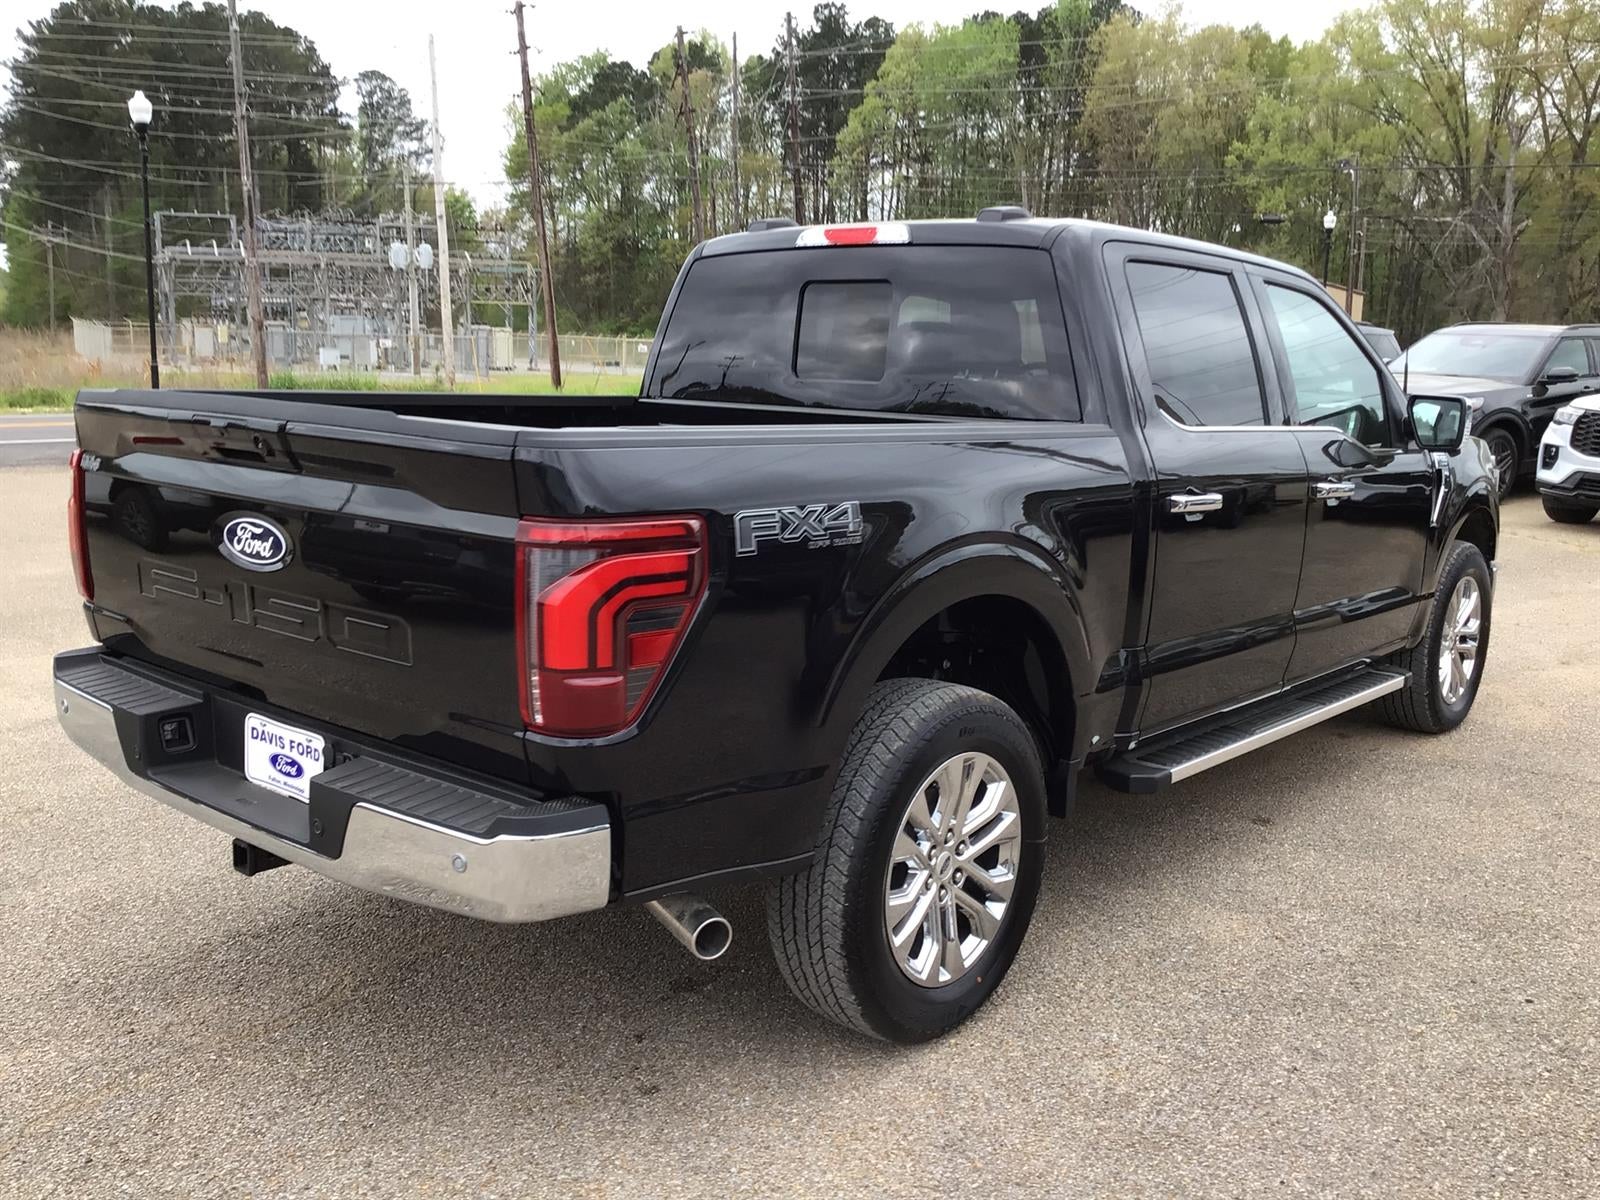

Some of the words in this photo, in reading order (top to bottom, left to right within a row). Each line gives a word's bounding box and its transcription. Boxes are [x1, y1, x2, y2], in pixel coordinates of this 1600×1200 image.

[233, 522, 274, 558] Ford
[733, 500, 863, 557] FX4
[137, 557, 413, 666] F-150
[250, 726, 285, 750] DAVIS
[289, 739, 321, 762] FORD
[276, 755, 298, 776] Ford
